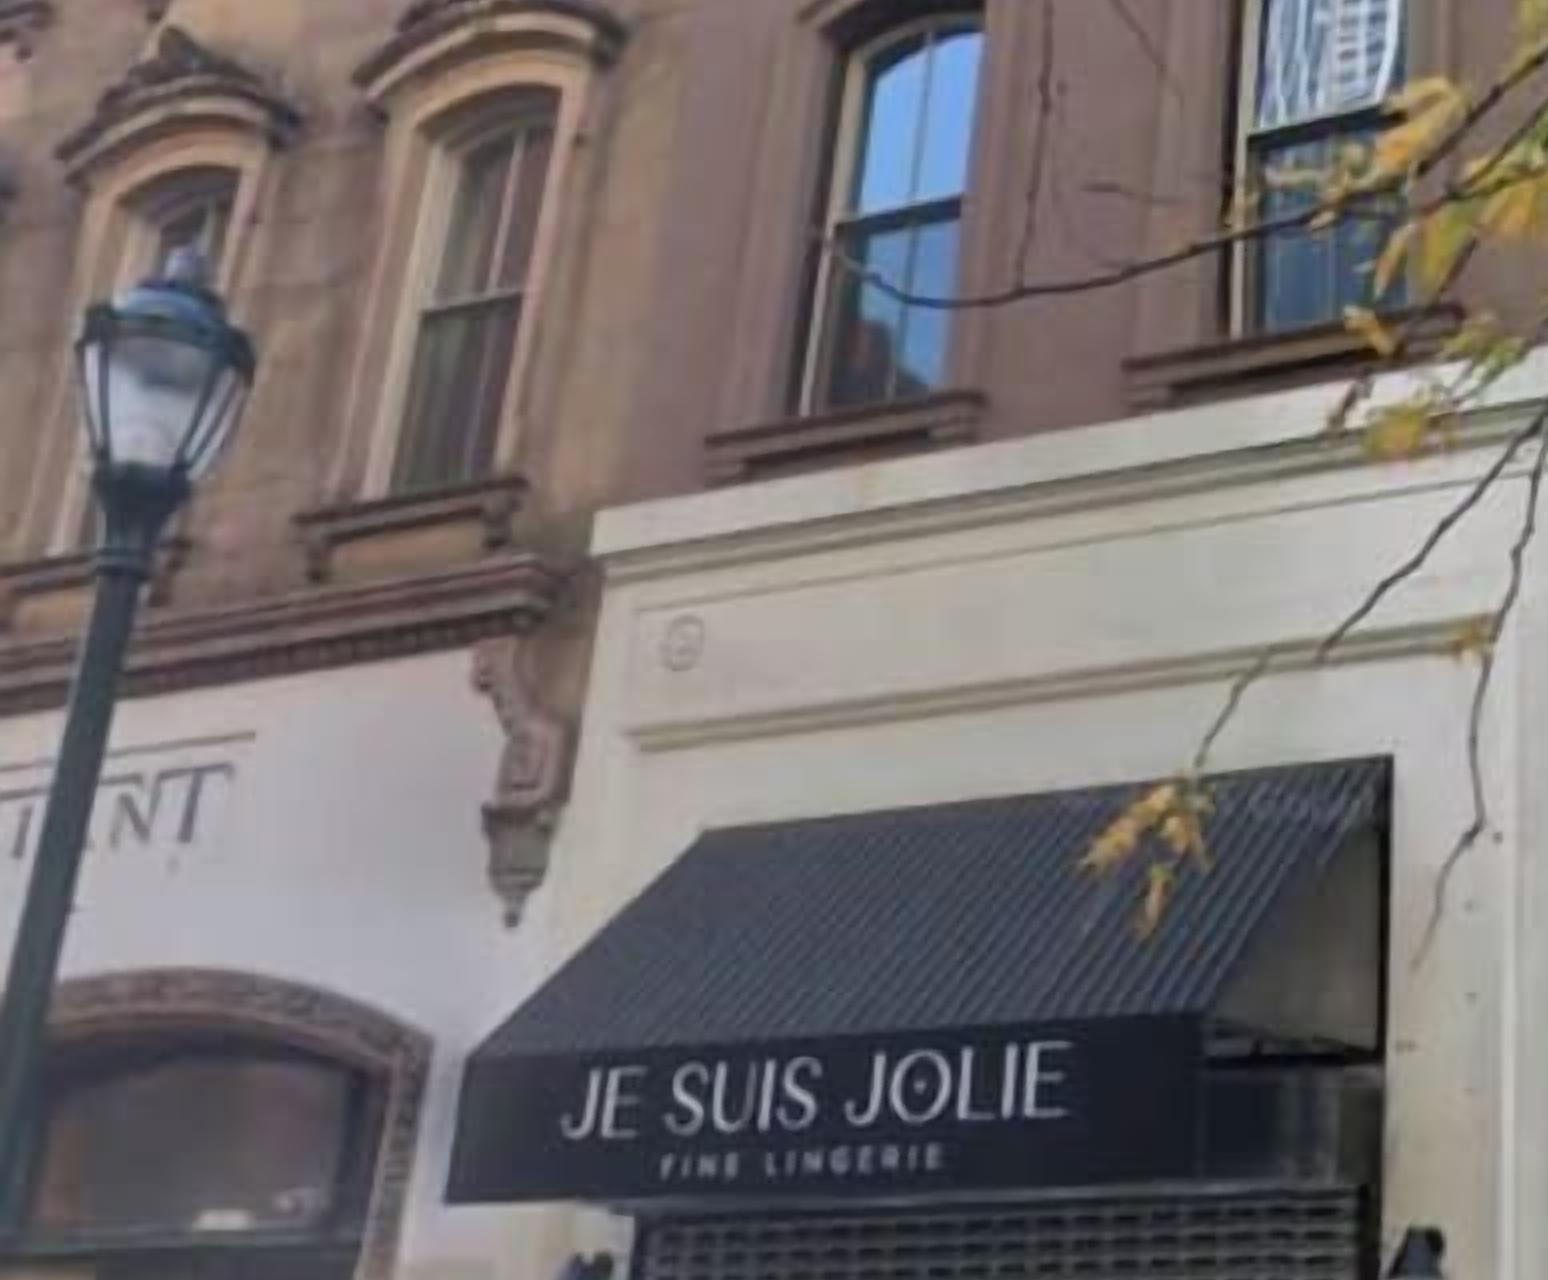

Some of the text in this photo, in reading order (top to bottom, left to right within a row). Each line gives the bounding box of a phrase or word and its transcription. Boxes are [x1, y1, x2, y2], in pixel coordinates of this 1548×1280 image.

[560, 1039, 1074, 1141] JE SUIS JOLIE
[659, 1142, 943, 1181] FINE LINGERIE
